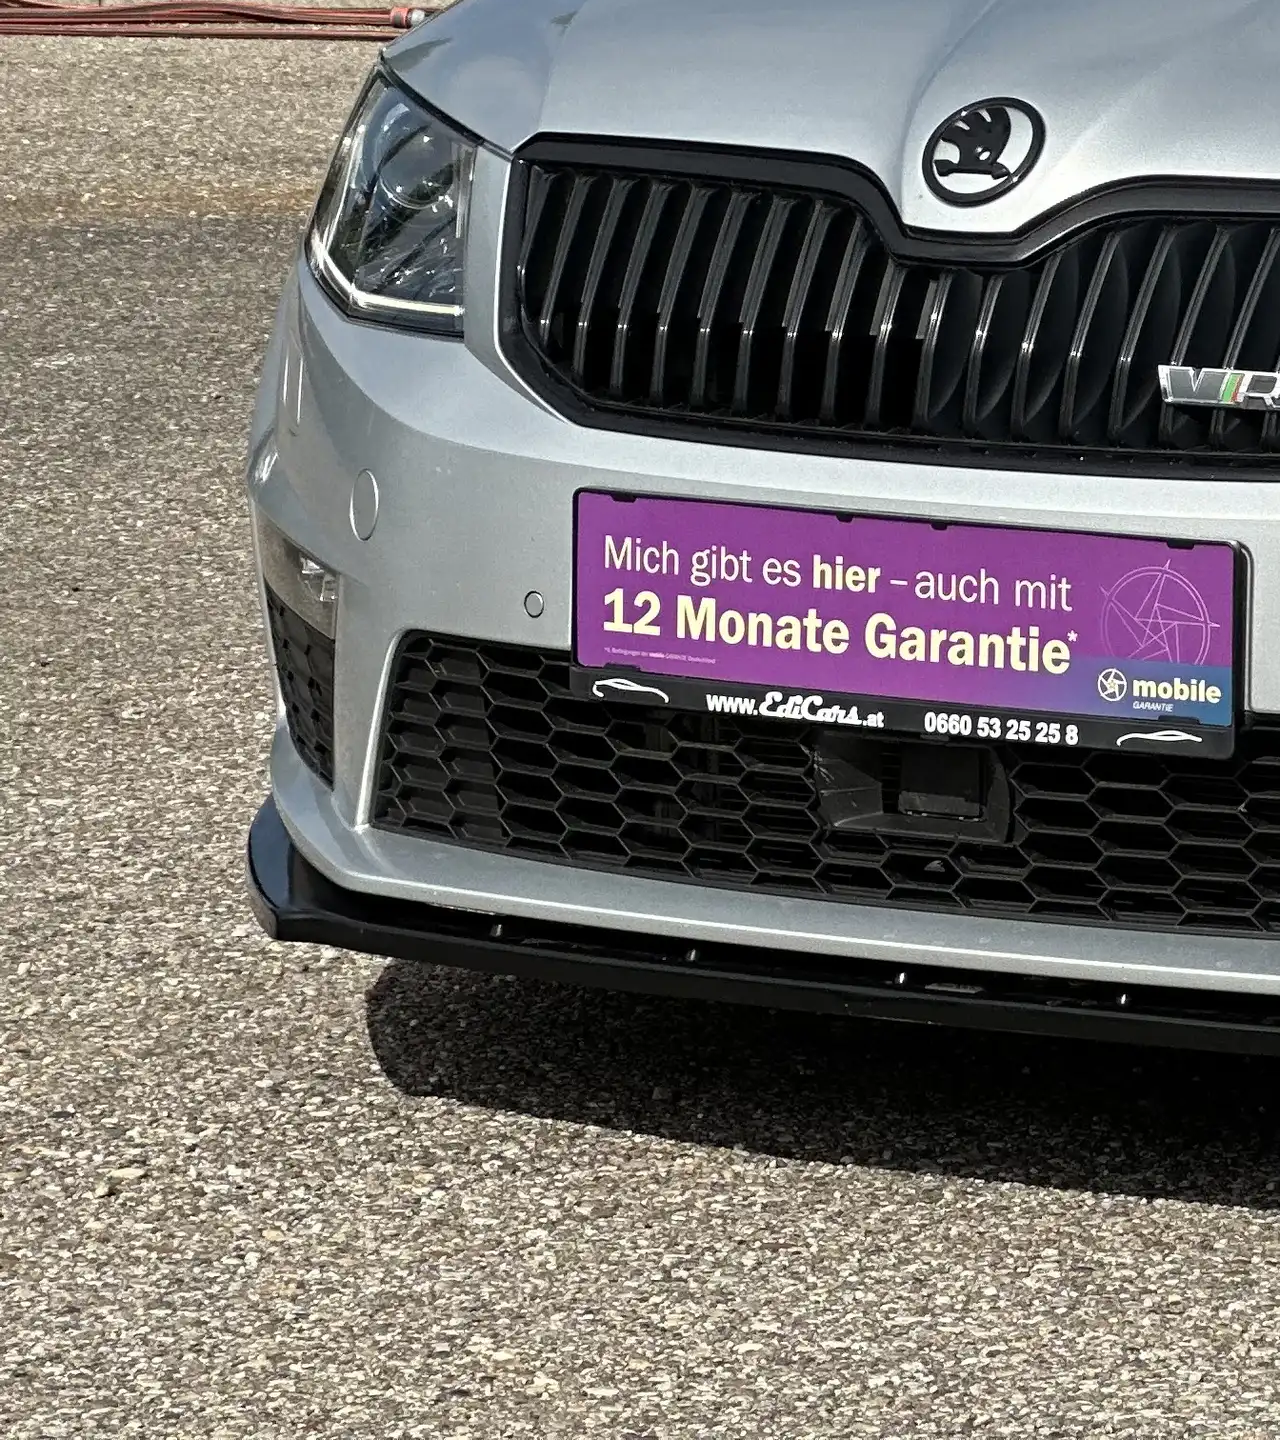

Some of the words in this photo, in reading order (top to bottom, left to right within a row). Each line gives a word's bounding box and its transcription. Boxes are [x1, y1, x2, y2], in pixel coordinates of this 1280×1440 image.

[604, 534, 680, 576] Mich
[690, 544, 753, 587] gibt
[762, 557, 802, 587] es
[812, 553, 881, 594] hier
[914, 568, 999, 605] auch
[1015, 574, 1073, 612] mit
[603, 587, 661, 636] 12
[676, 594, 850, 654] Monate
[1132, 677, 1222, 704] mobile
[1132, 701, 1174, 712] GARANTIE
[706, 691, 885, 728] www.EdiCars.at
[924, 711, 972, 736] 0660
[976, 716, 1001, 739] 53
[1005, 719, 1032, 742] 25
[1034, 722, 1061, 745] 25
[1064, 724, 1079, 746] 8
